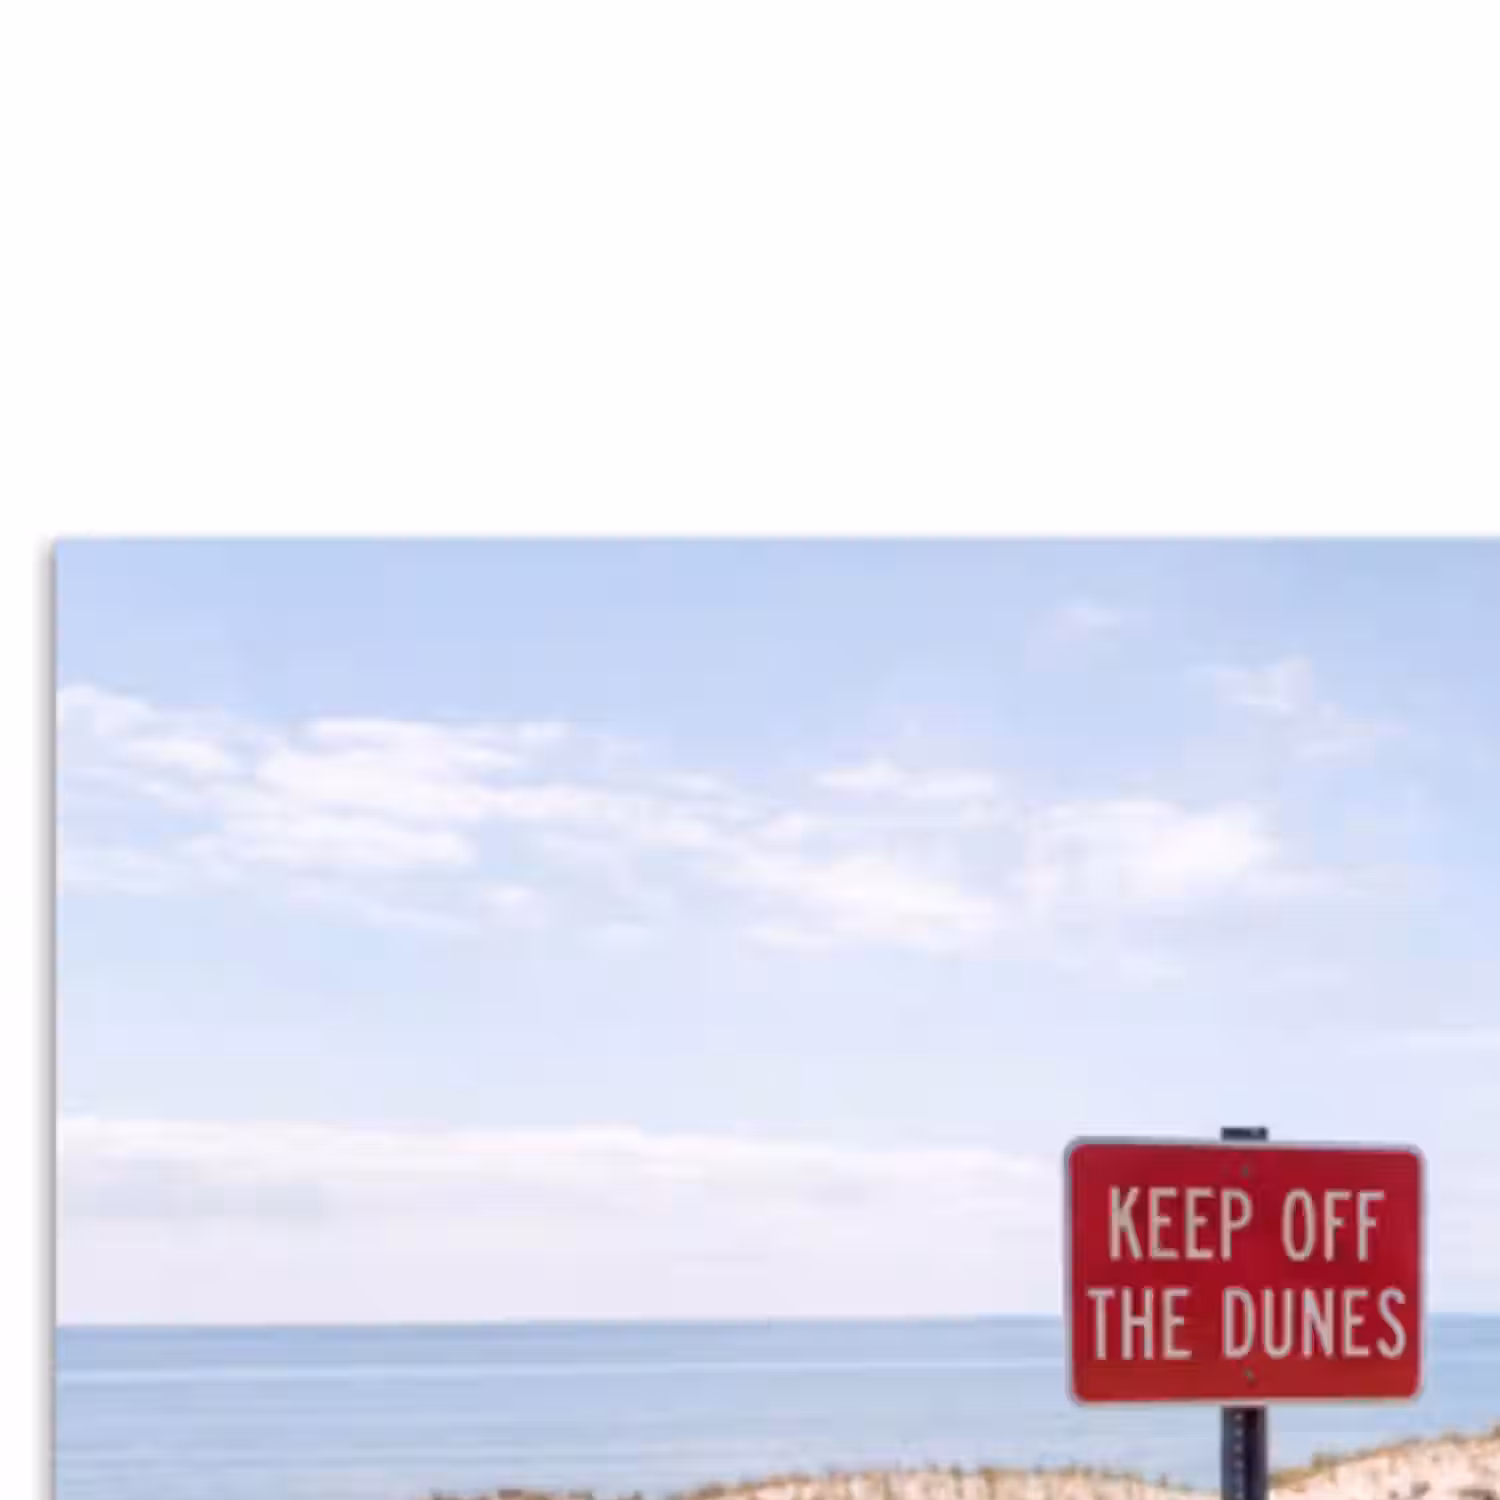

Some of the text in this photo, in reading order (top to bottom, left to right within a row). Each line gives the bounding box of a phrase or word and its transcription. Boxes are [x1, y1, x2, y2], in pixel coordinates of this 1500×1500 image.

[1108, 1186, 1386, 1263] KEEP OFF
[1086, 1286, 1408, 1361] THE DUNES
